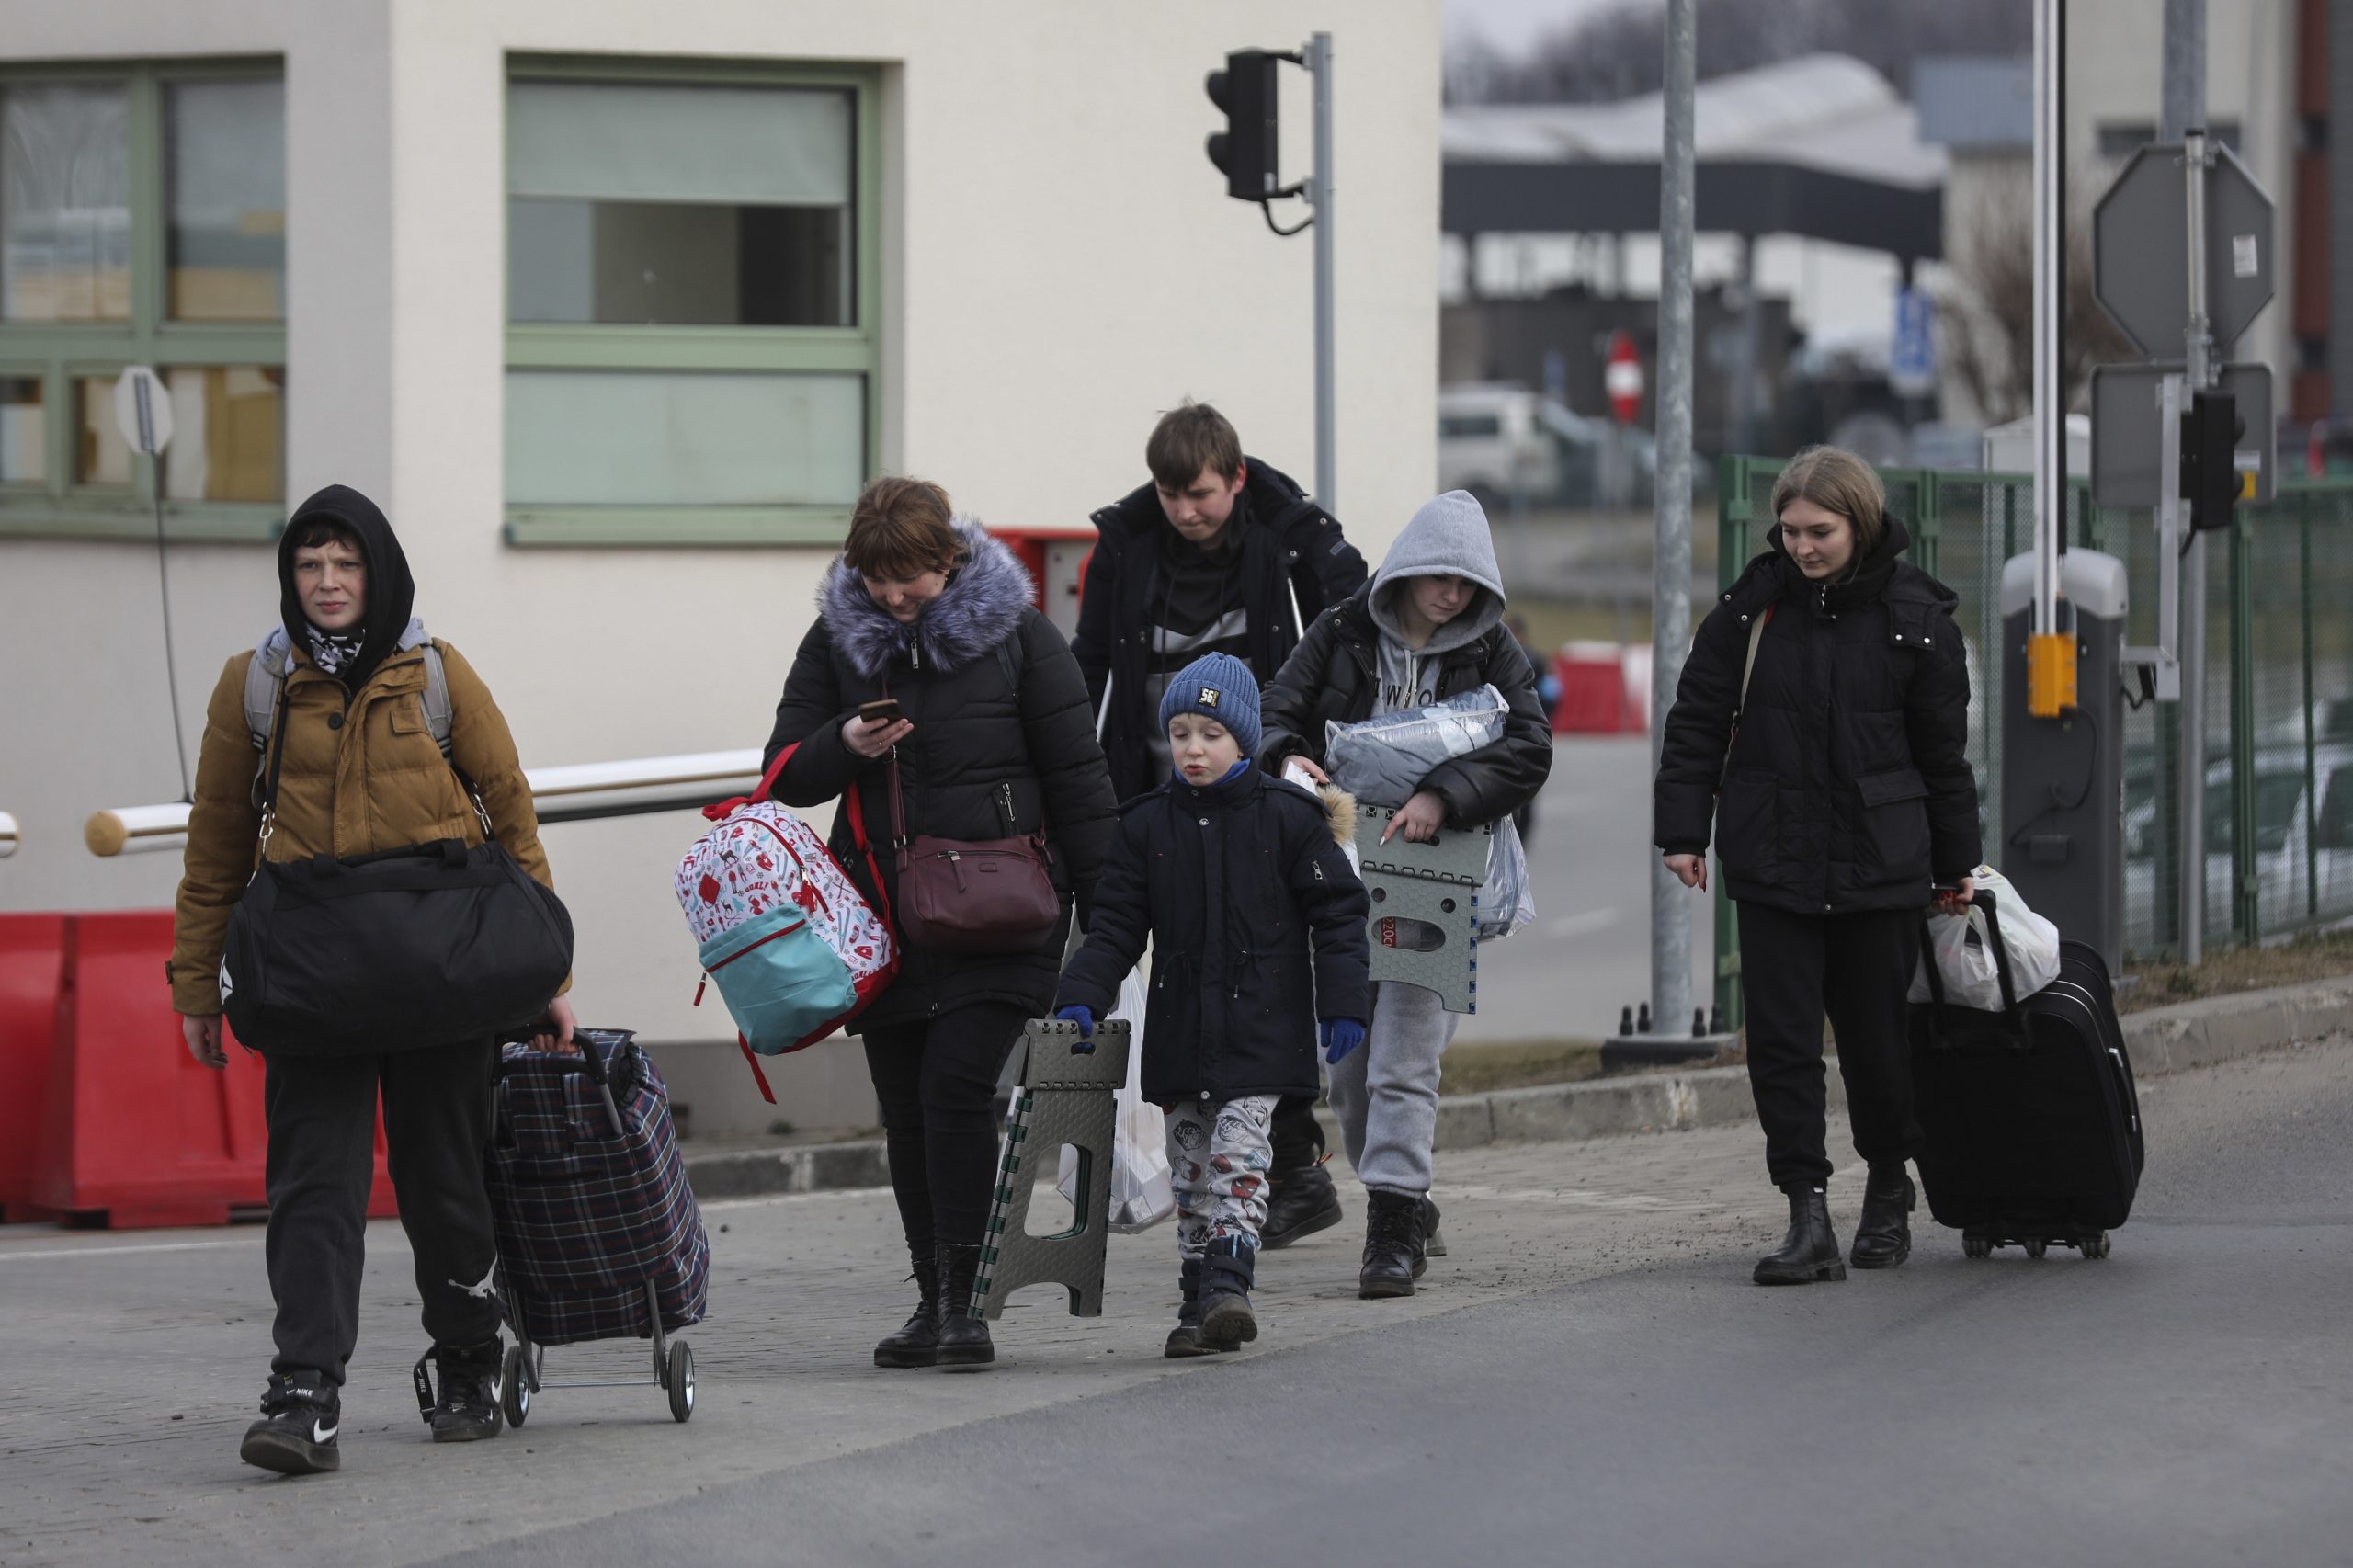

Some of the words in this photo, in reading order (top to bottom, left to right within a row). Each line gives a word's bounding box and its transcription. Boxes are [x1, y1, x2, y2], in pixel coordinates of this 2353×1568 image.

[1200, 687, 1214, 704] 56
[1382, 917, 1394, 947] 220c
[295, 1387, 313, 1397] NIKE
[418, 1378, 427, 1393] NIKE
